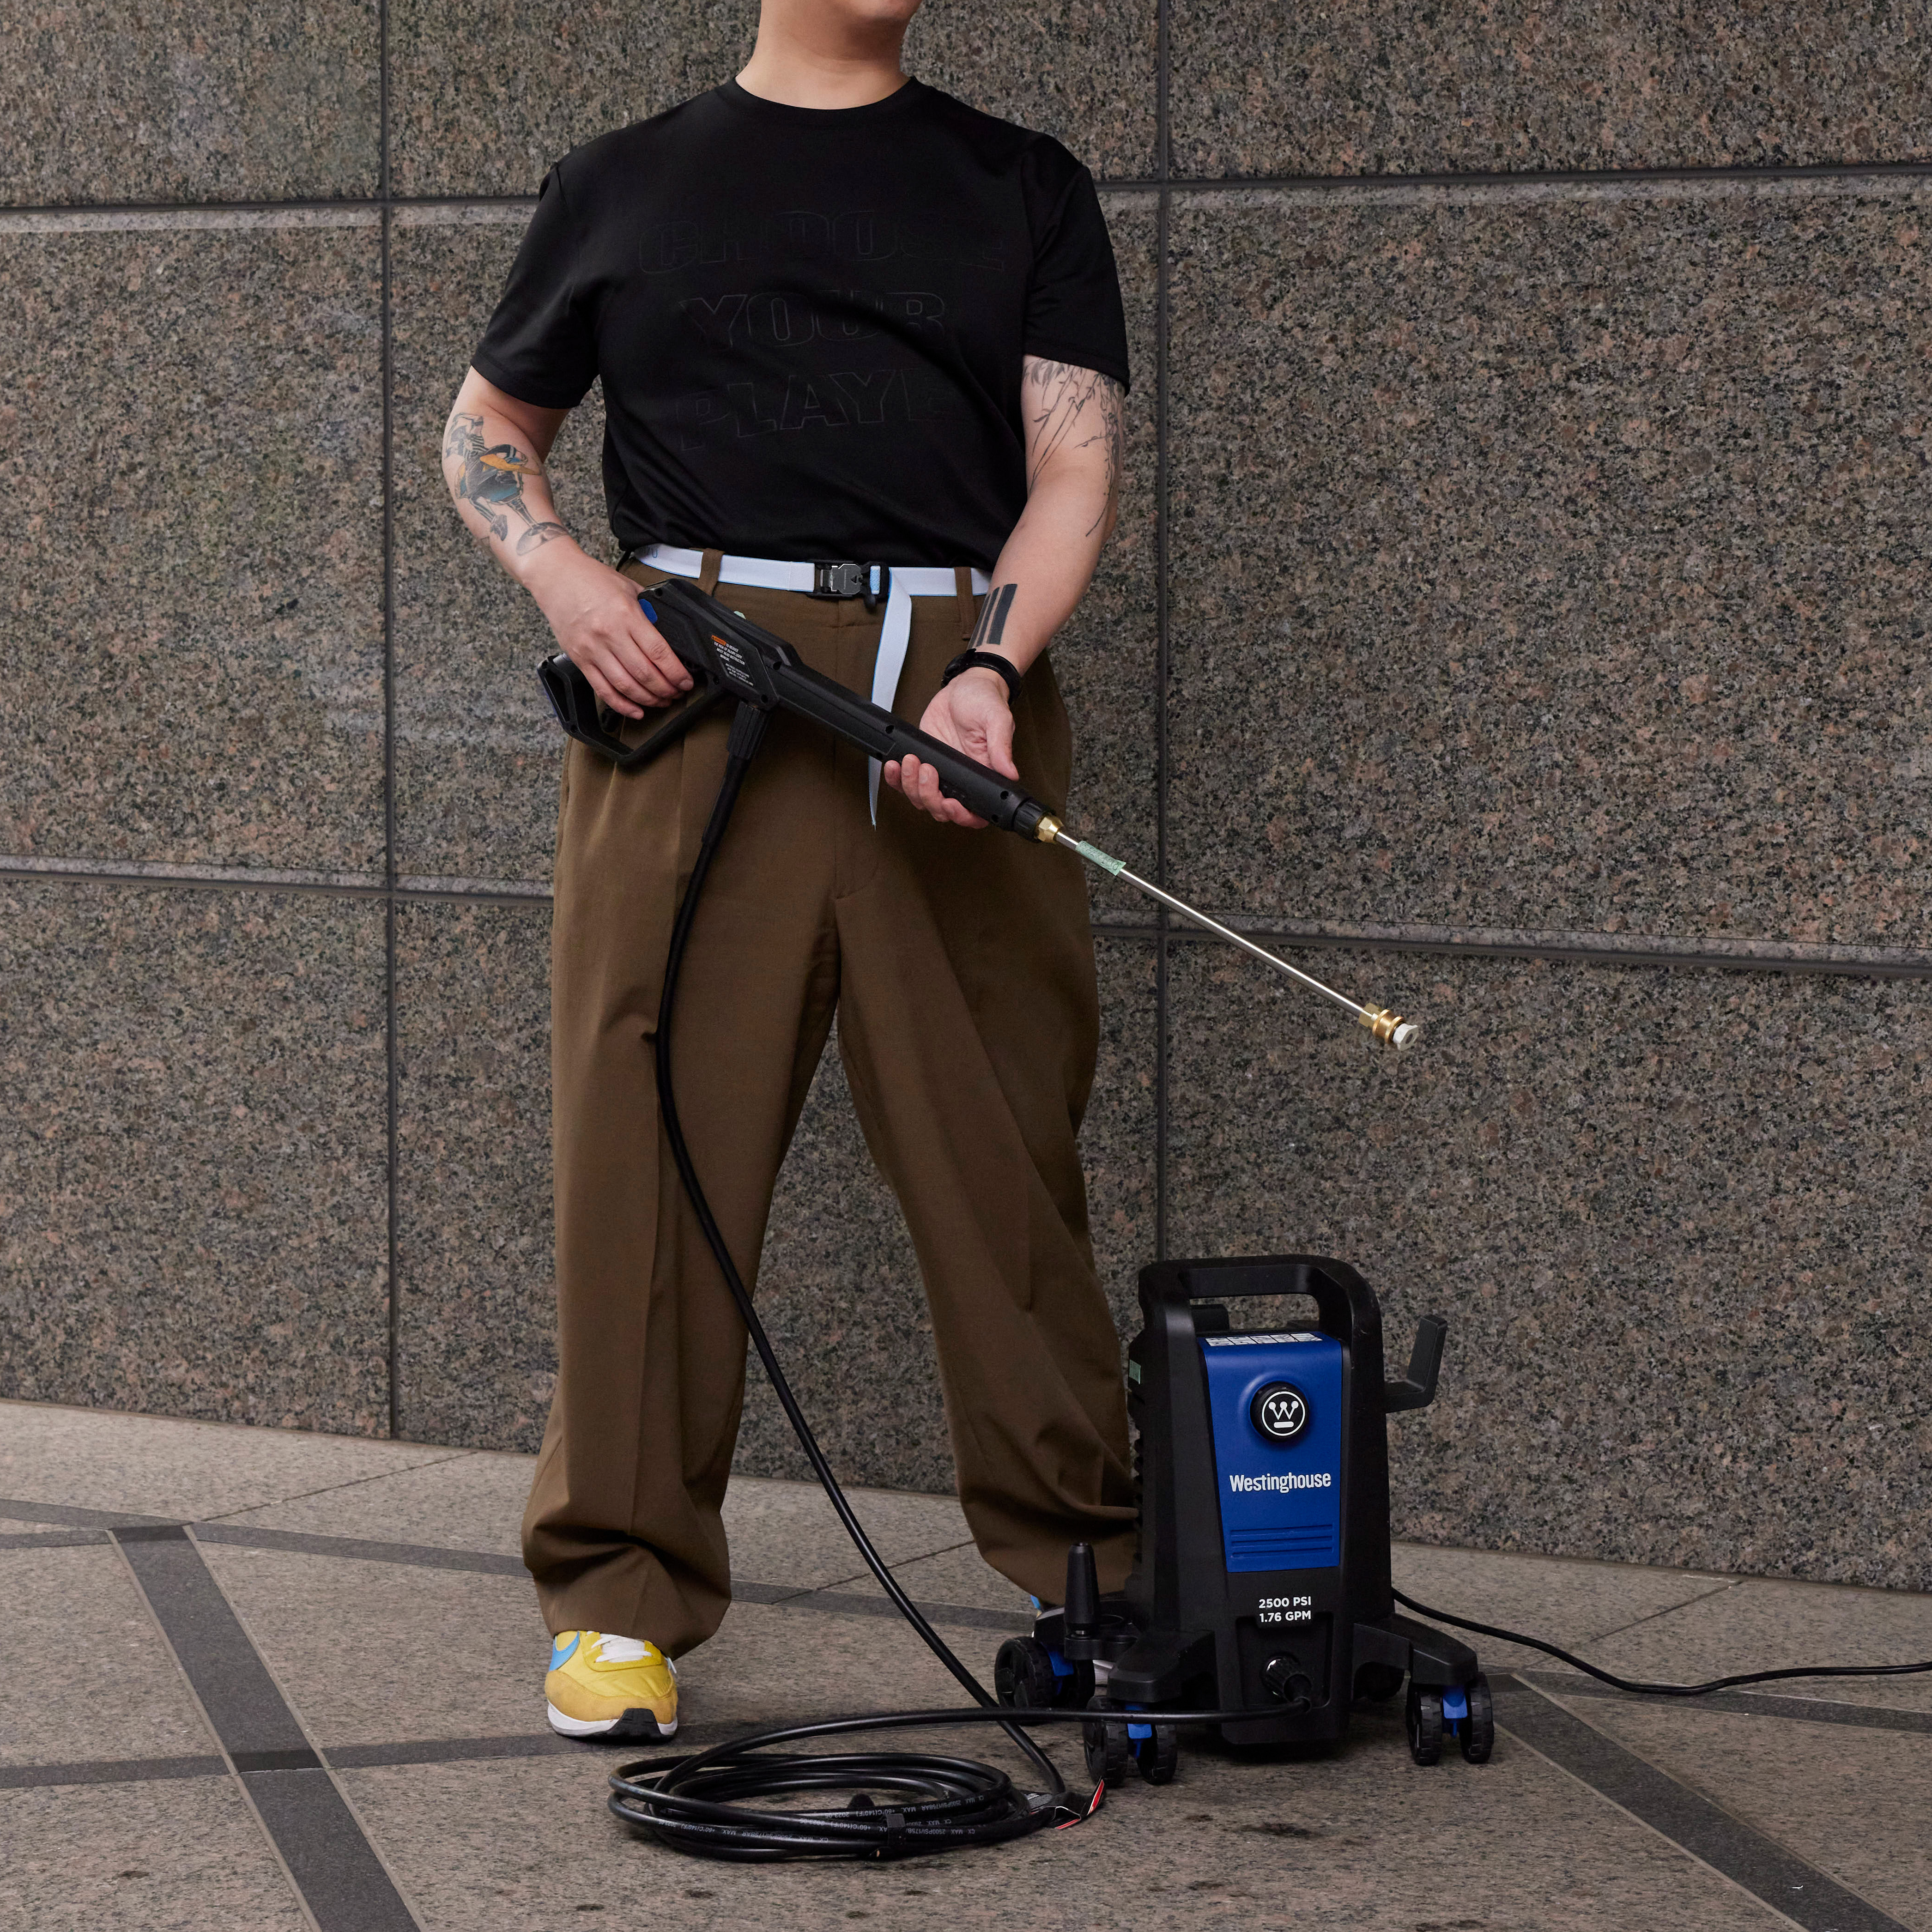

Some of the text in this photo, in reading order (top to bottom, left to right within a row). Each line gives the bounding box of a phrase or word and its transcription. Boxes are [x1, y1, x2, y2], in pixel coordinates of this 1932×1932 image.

[1229, 1472, 1331, 1493] Westinghouse
[1259, 1596, 1311, 1608] 2500 PSI
[1259, 1611, 1311, 1623] 1.76 GPM
